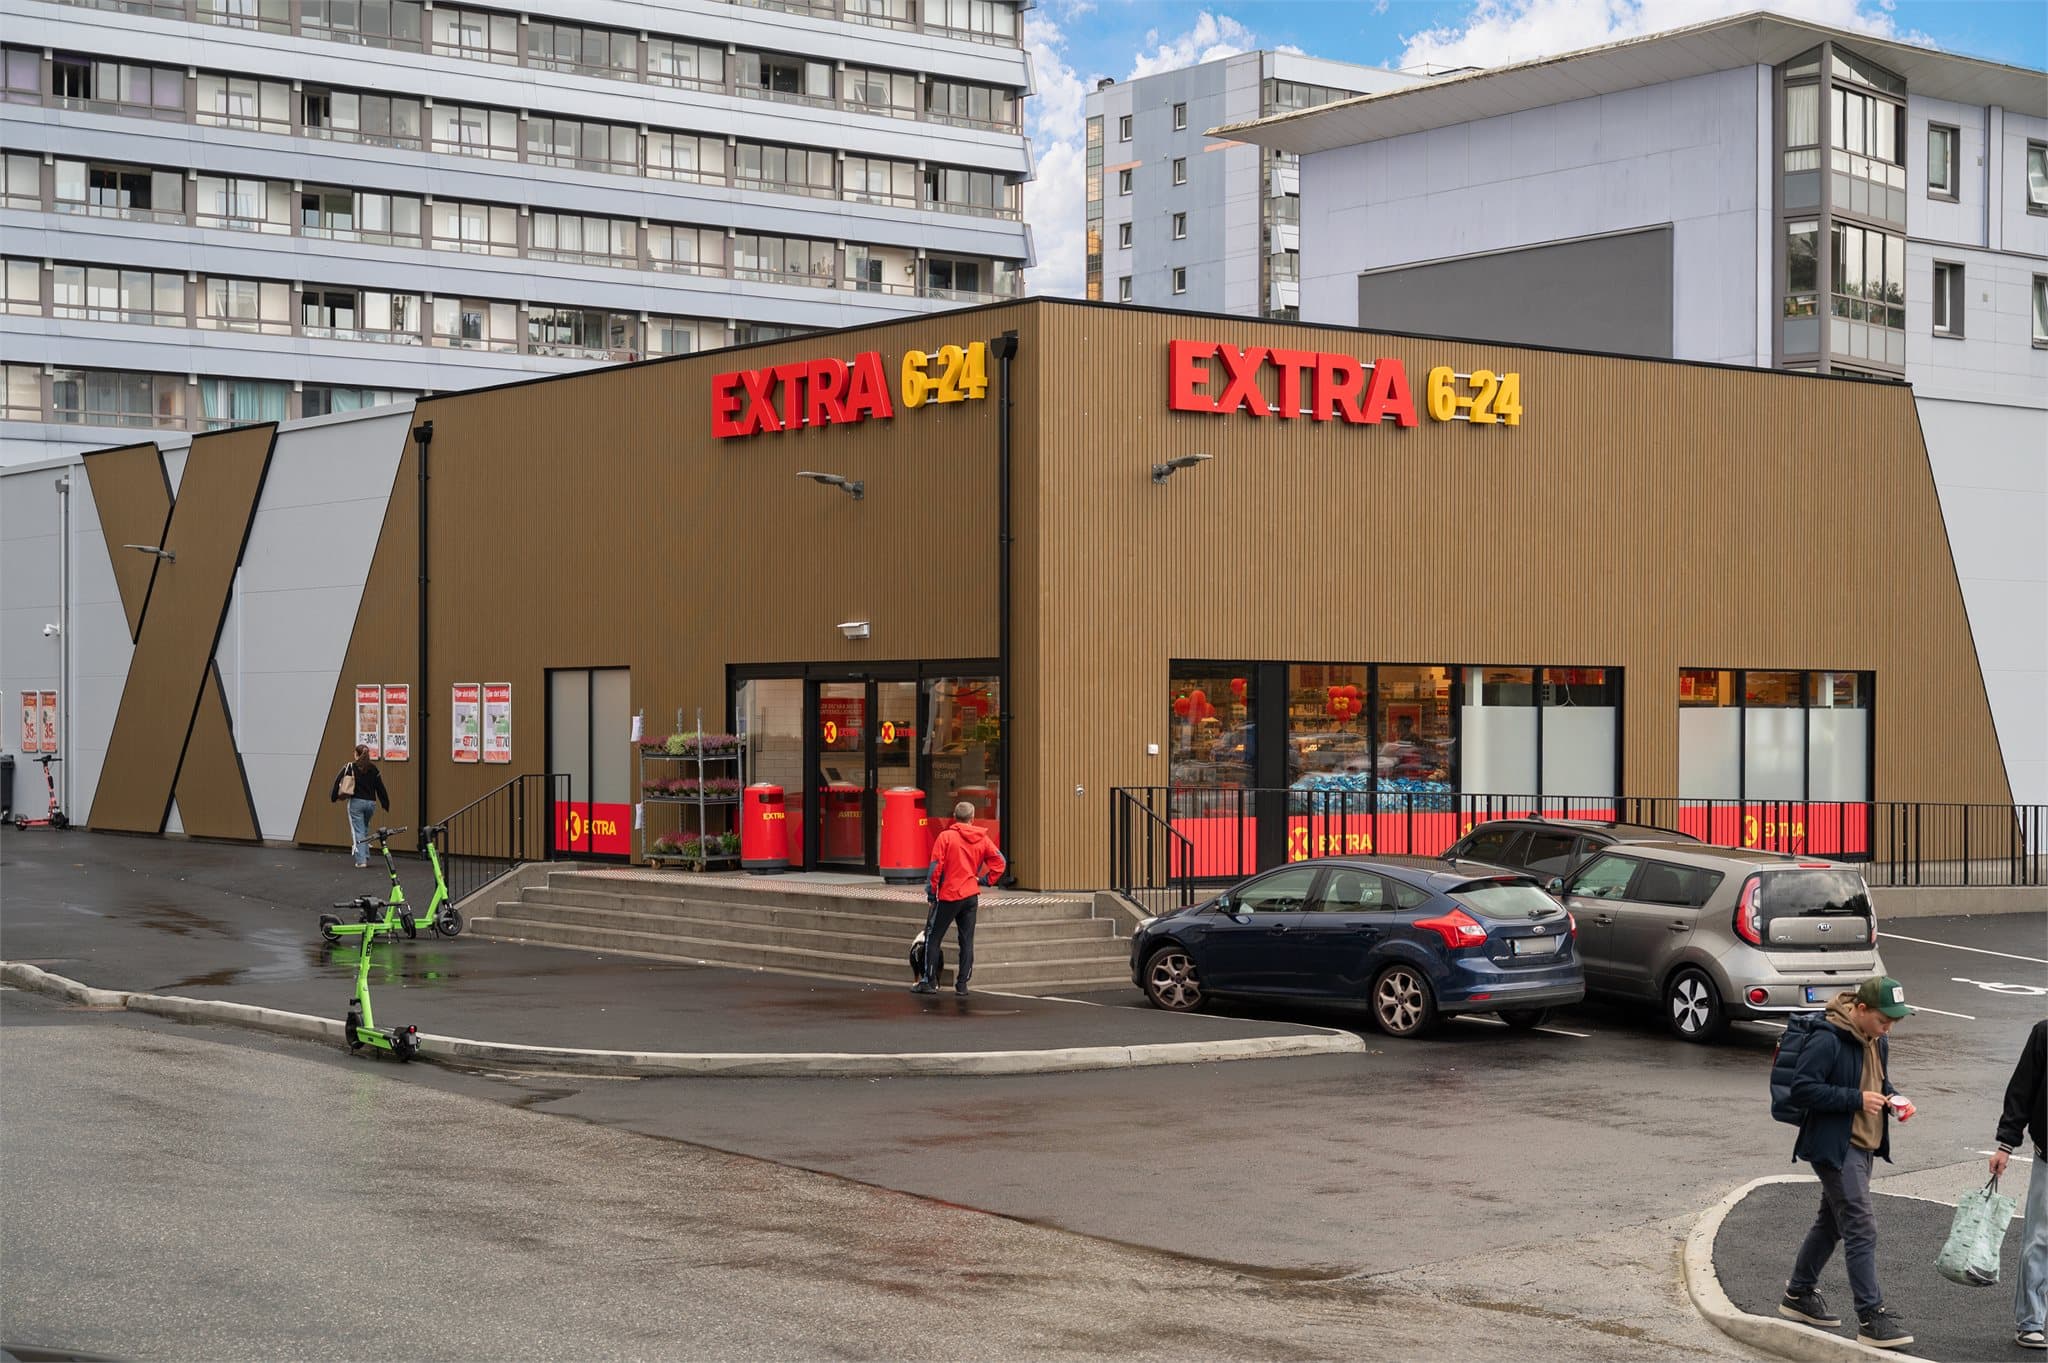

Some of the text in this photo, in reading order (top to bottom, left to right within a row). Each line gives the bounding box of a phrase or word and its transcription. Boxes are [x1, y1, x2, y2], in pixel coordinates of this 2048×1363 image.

[712, 341, 989, 439] EXTRA 6-24
[1169, 339, 1523, 427] EXTRA 6-24
